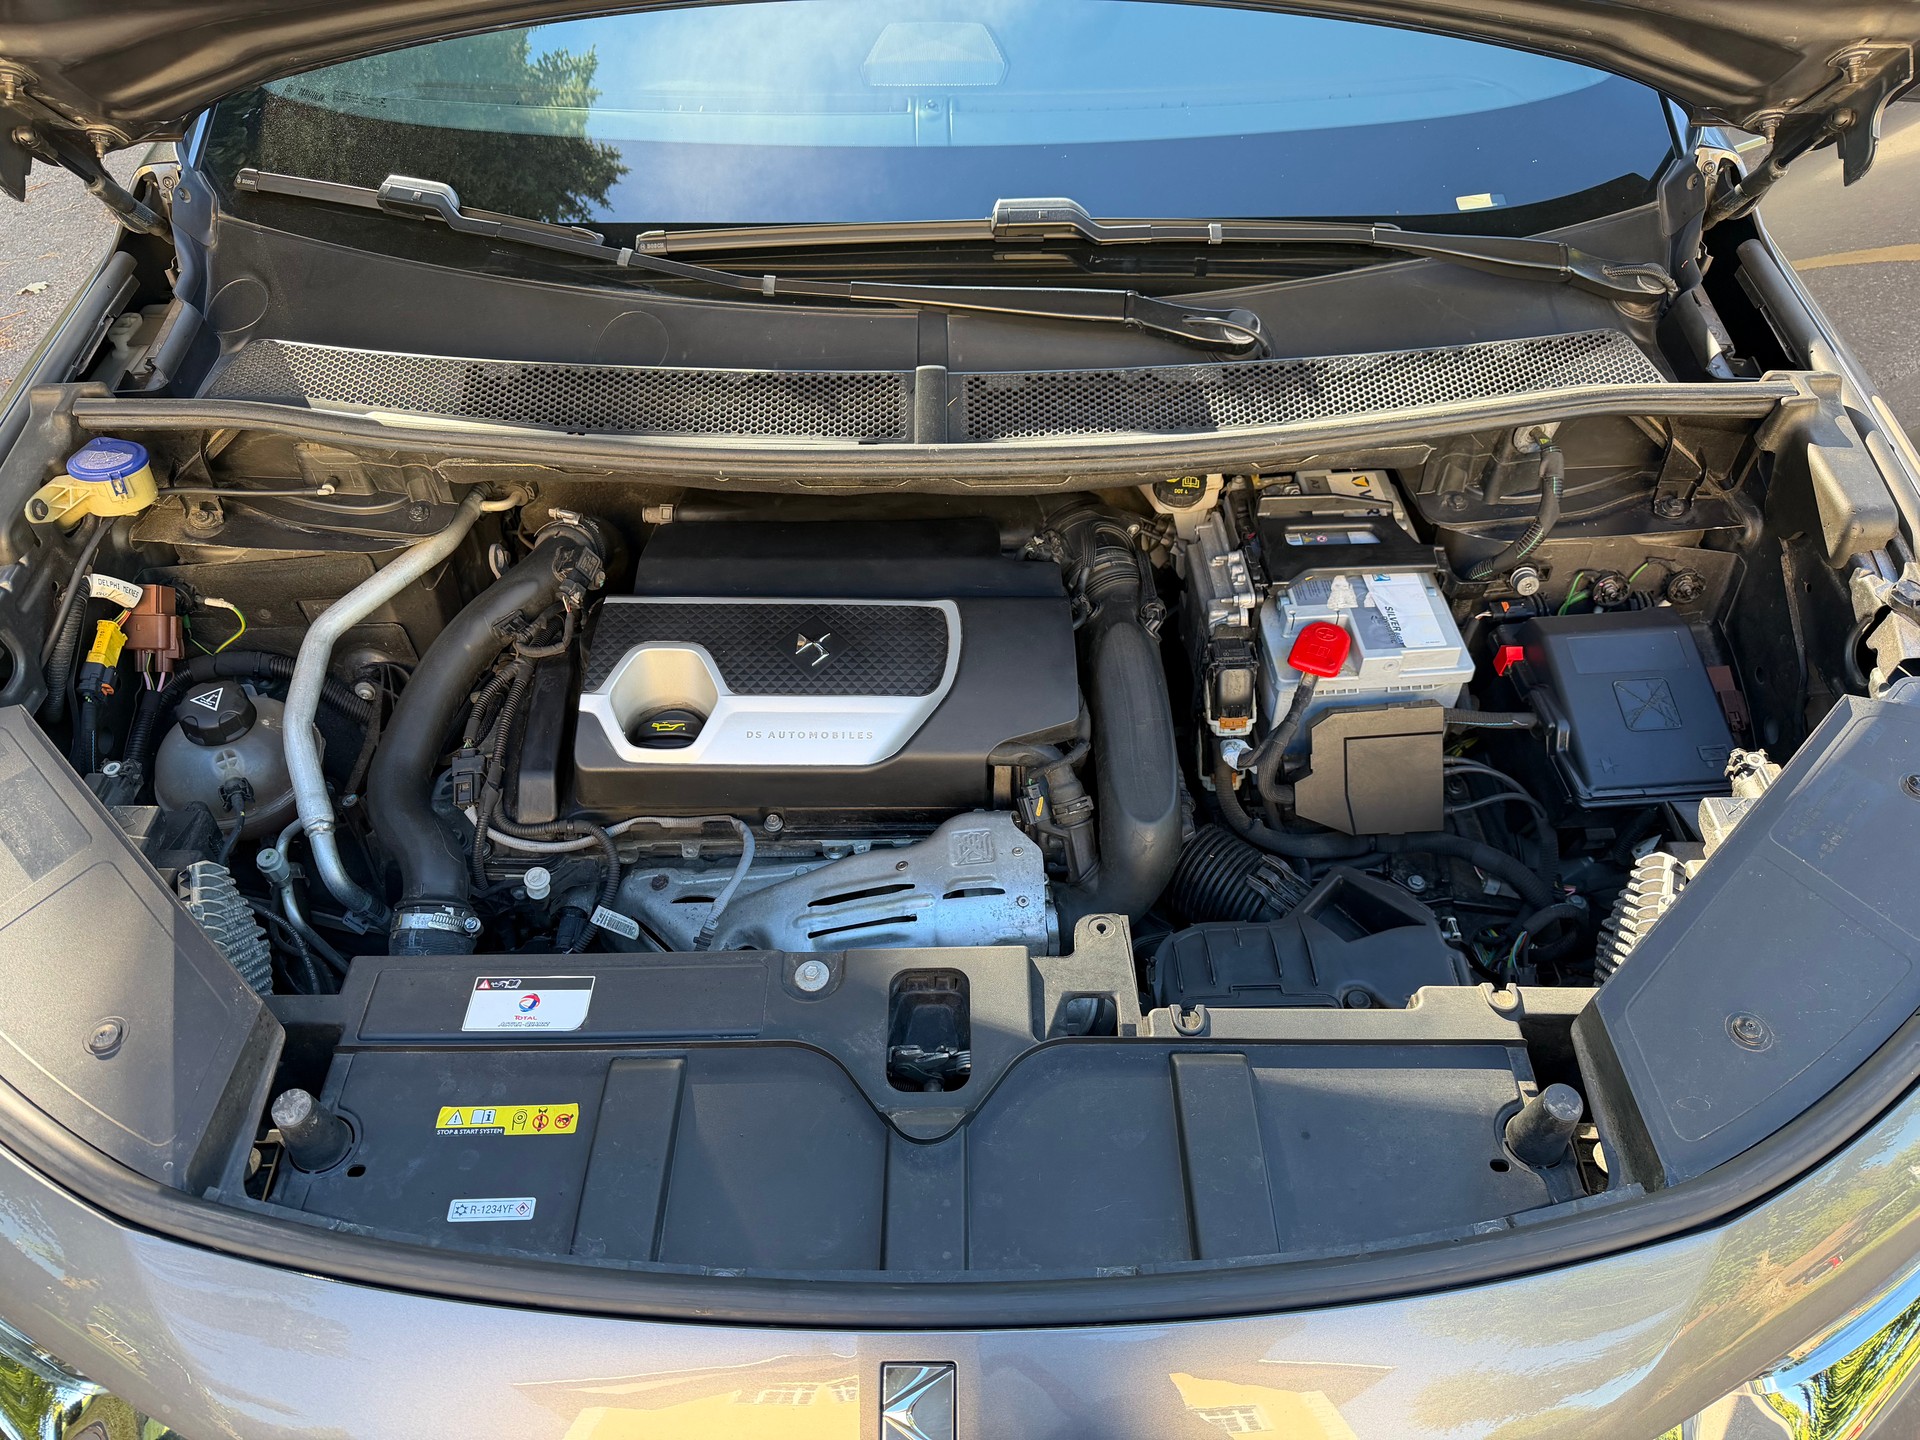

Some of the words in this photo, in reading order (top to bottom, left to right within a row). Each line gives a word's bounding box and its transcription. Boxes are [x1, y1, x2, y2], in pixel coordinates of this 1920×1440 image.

[98, 579, 120, 590] DELPHI
[1384, 606, 1402, 632] SILVER
[746, 731, 762, 739] DS
[768, 731, 873, 739] AUTOMOBILES
[470, 1204, 514, 1214] R-1234YF
